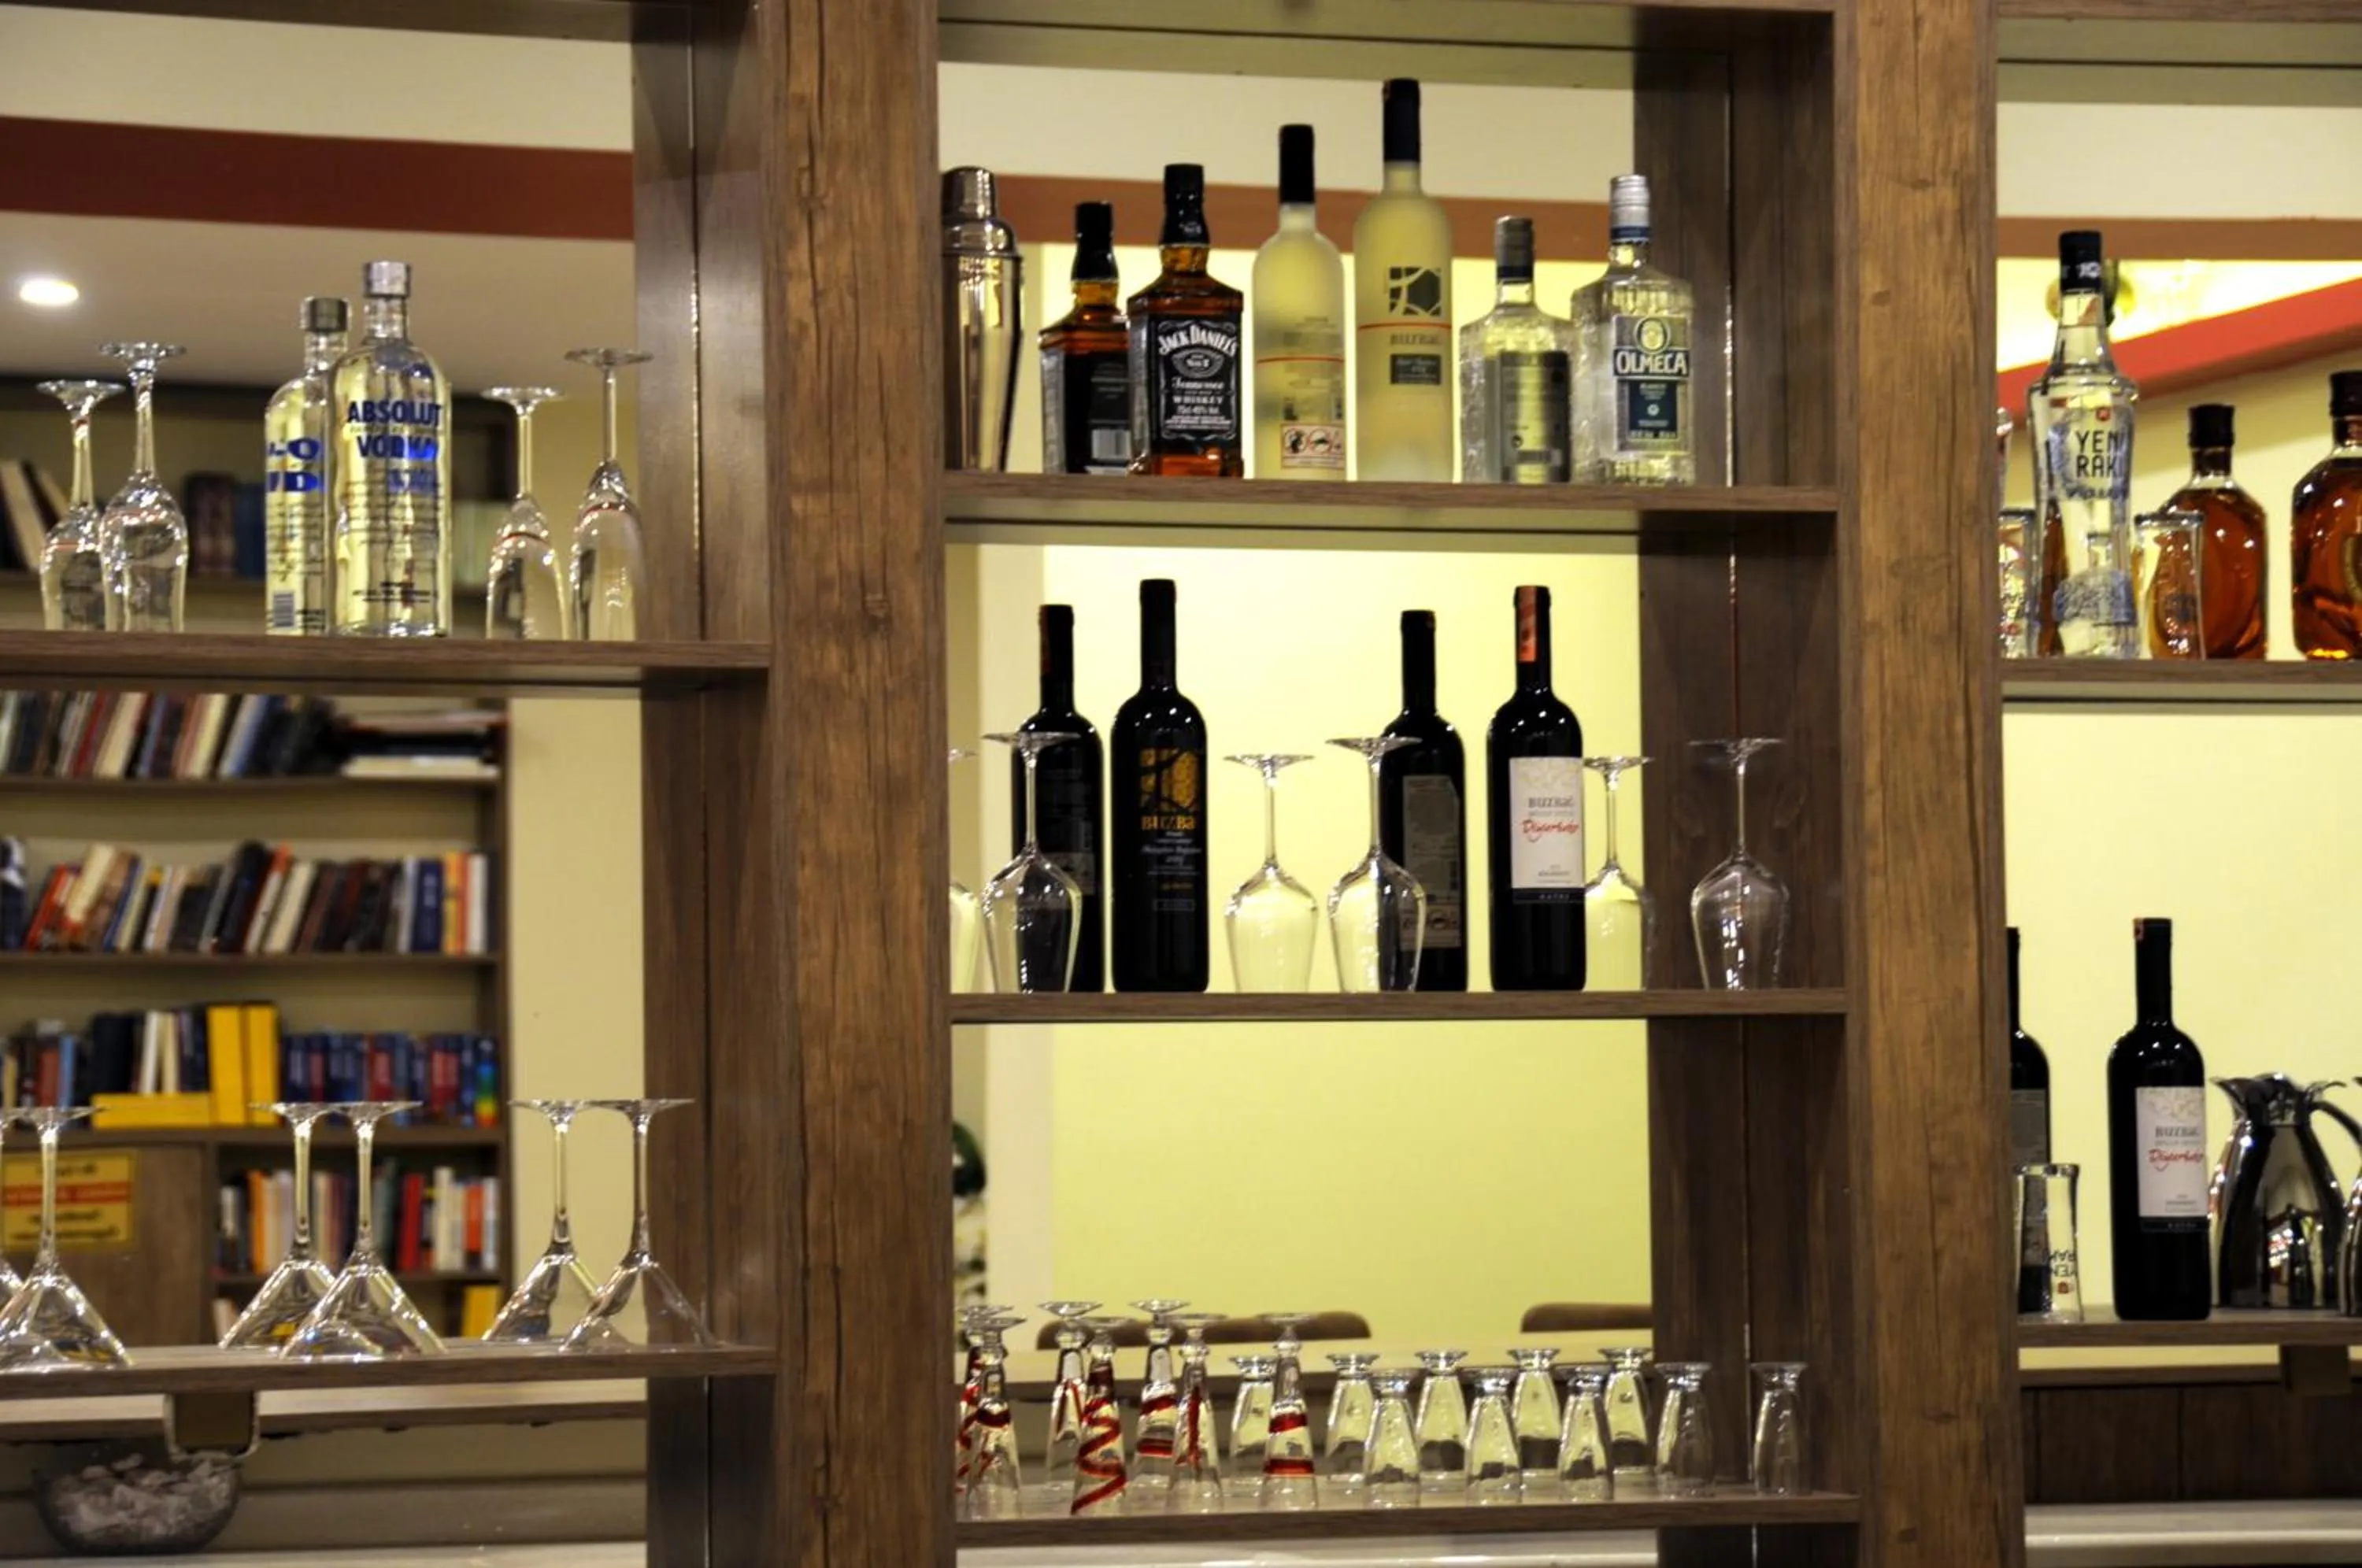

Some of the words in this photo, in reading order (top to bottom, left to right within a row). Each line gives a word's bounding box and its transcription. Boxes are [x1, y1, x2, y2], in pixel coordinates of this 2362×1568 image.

[1158, 330, 1190, 355] JACK
[1615, 350, 1688, 375] OLMECA
[346, 399, 442, 427] ABSOLUT
